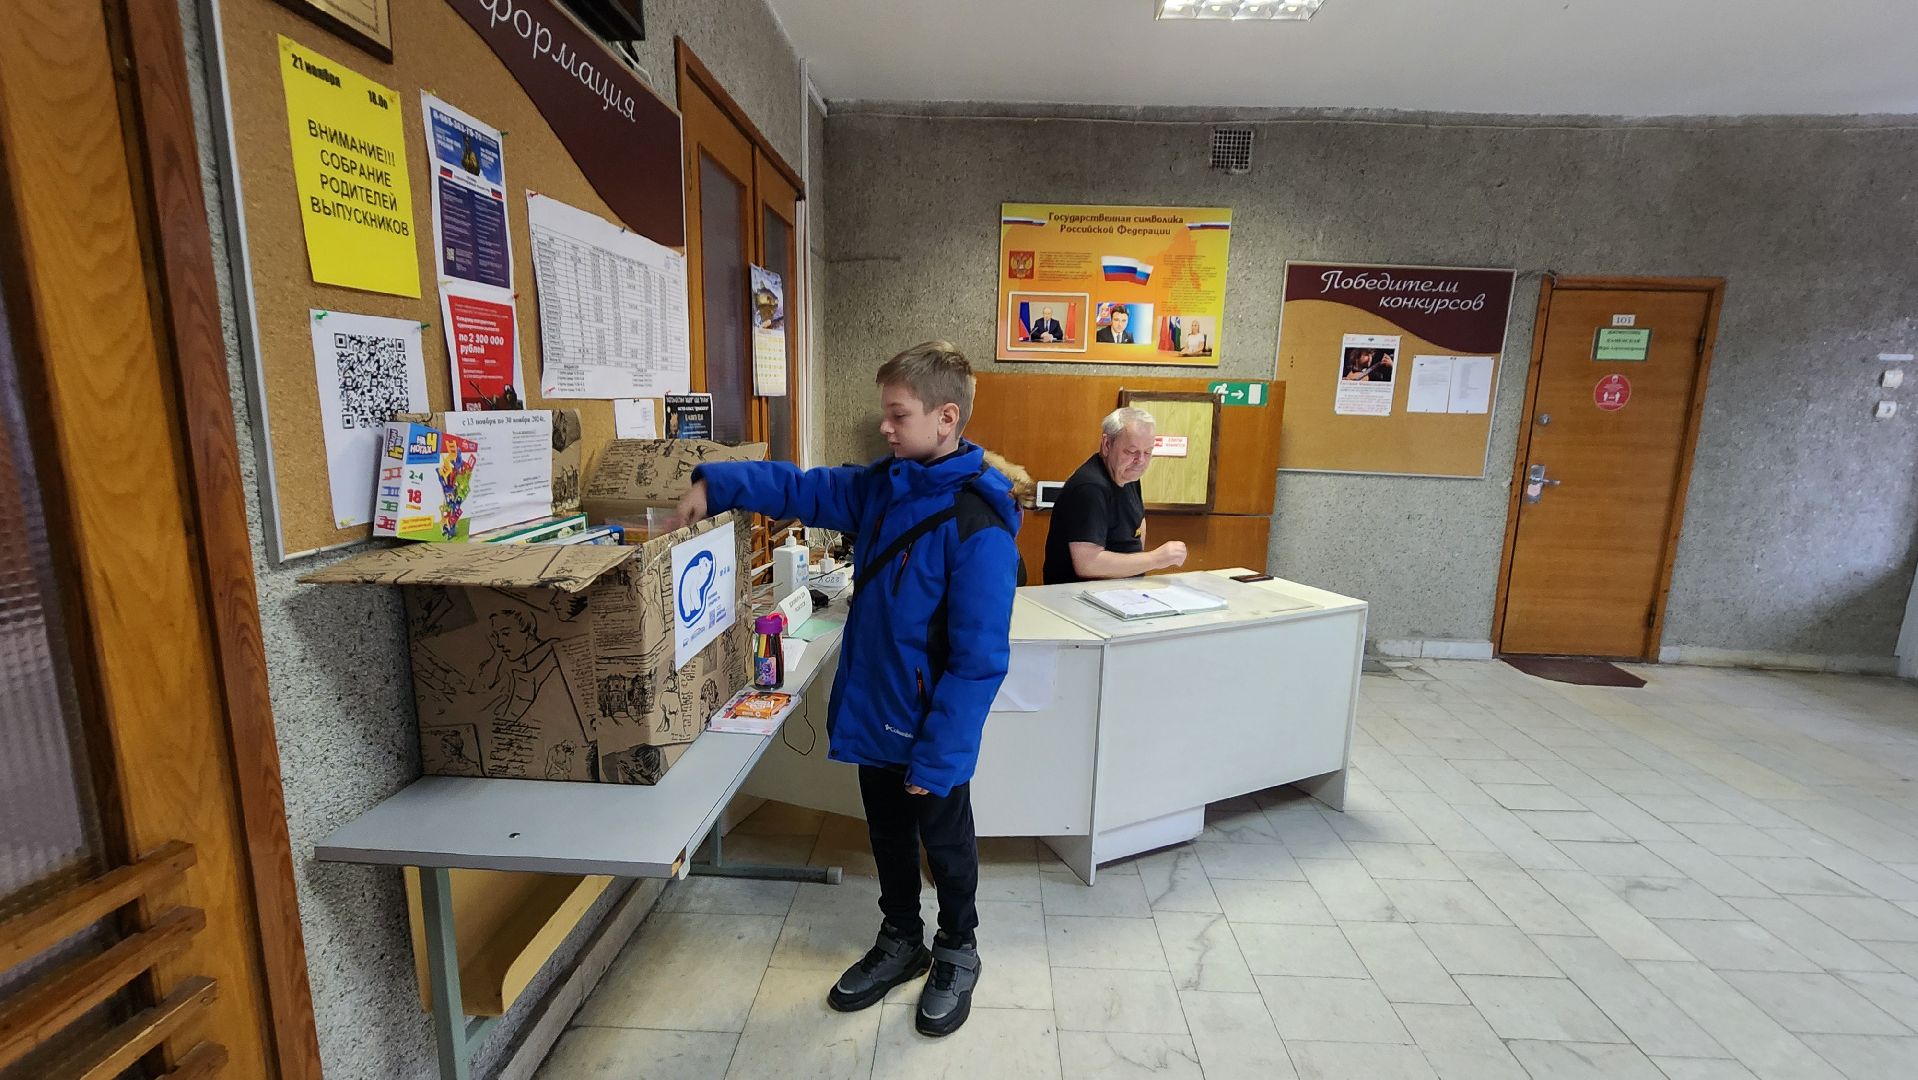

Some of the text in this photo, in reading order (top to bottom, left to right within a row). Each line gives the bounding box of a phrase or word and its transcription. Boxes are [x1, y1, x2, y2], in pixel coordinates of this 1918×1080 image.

[291, 54, 342, 88] 21 ноября
[308, 119, 396, 167] ВНИМАНИЕ!!!
[320, 150, 392, 187] СОБРАНИЕ
[320, 173, 398, 212] РОДИТЕЛЕЙ
[311, 196, 410, 236] ВЫПУСКНИКОВ
[1048, 212, 1184, 224] Государственная символика
[1060, 224, 1171, 236] Российской Федерации
[1320, 270, 1459, 294] Победители
[1379, 293, 1486, 315] конкурсов
[458, 333, 468, 342] по
[468, 333, 474, 343] 2
[490, 335, 505, 346] 000
[460, 343, 485, 355] рублей
[409, 470, 424, 481] 2-4
[407, 488, 422, 504] 18
